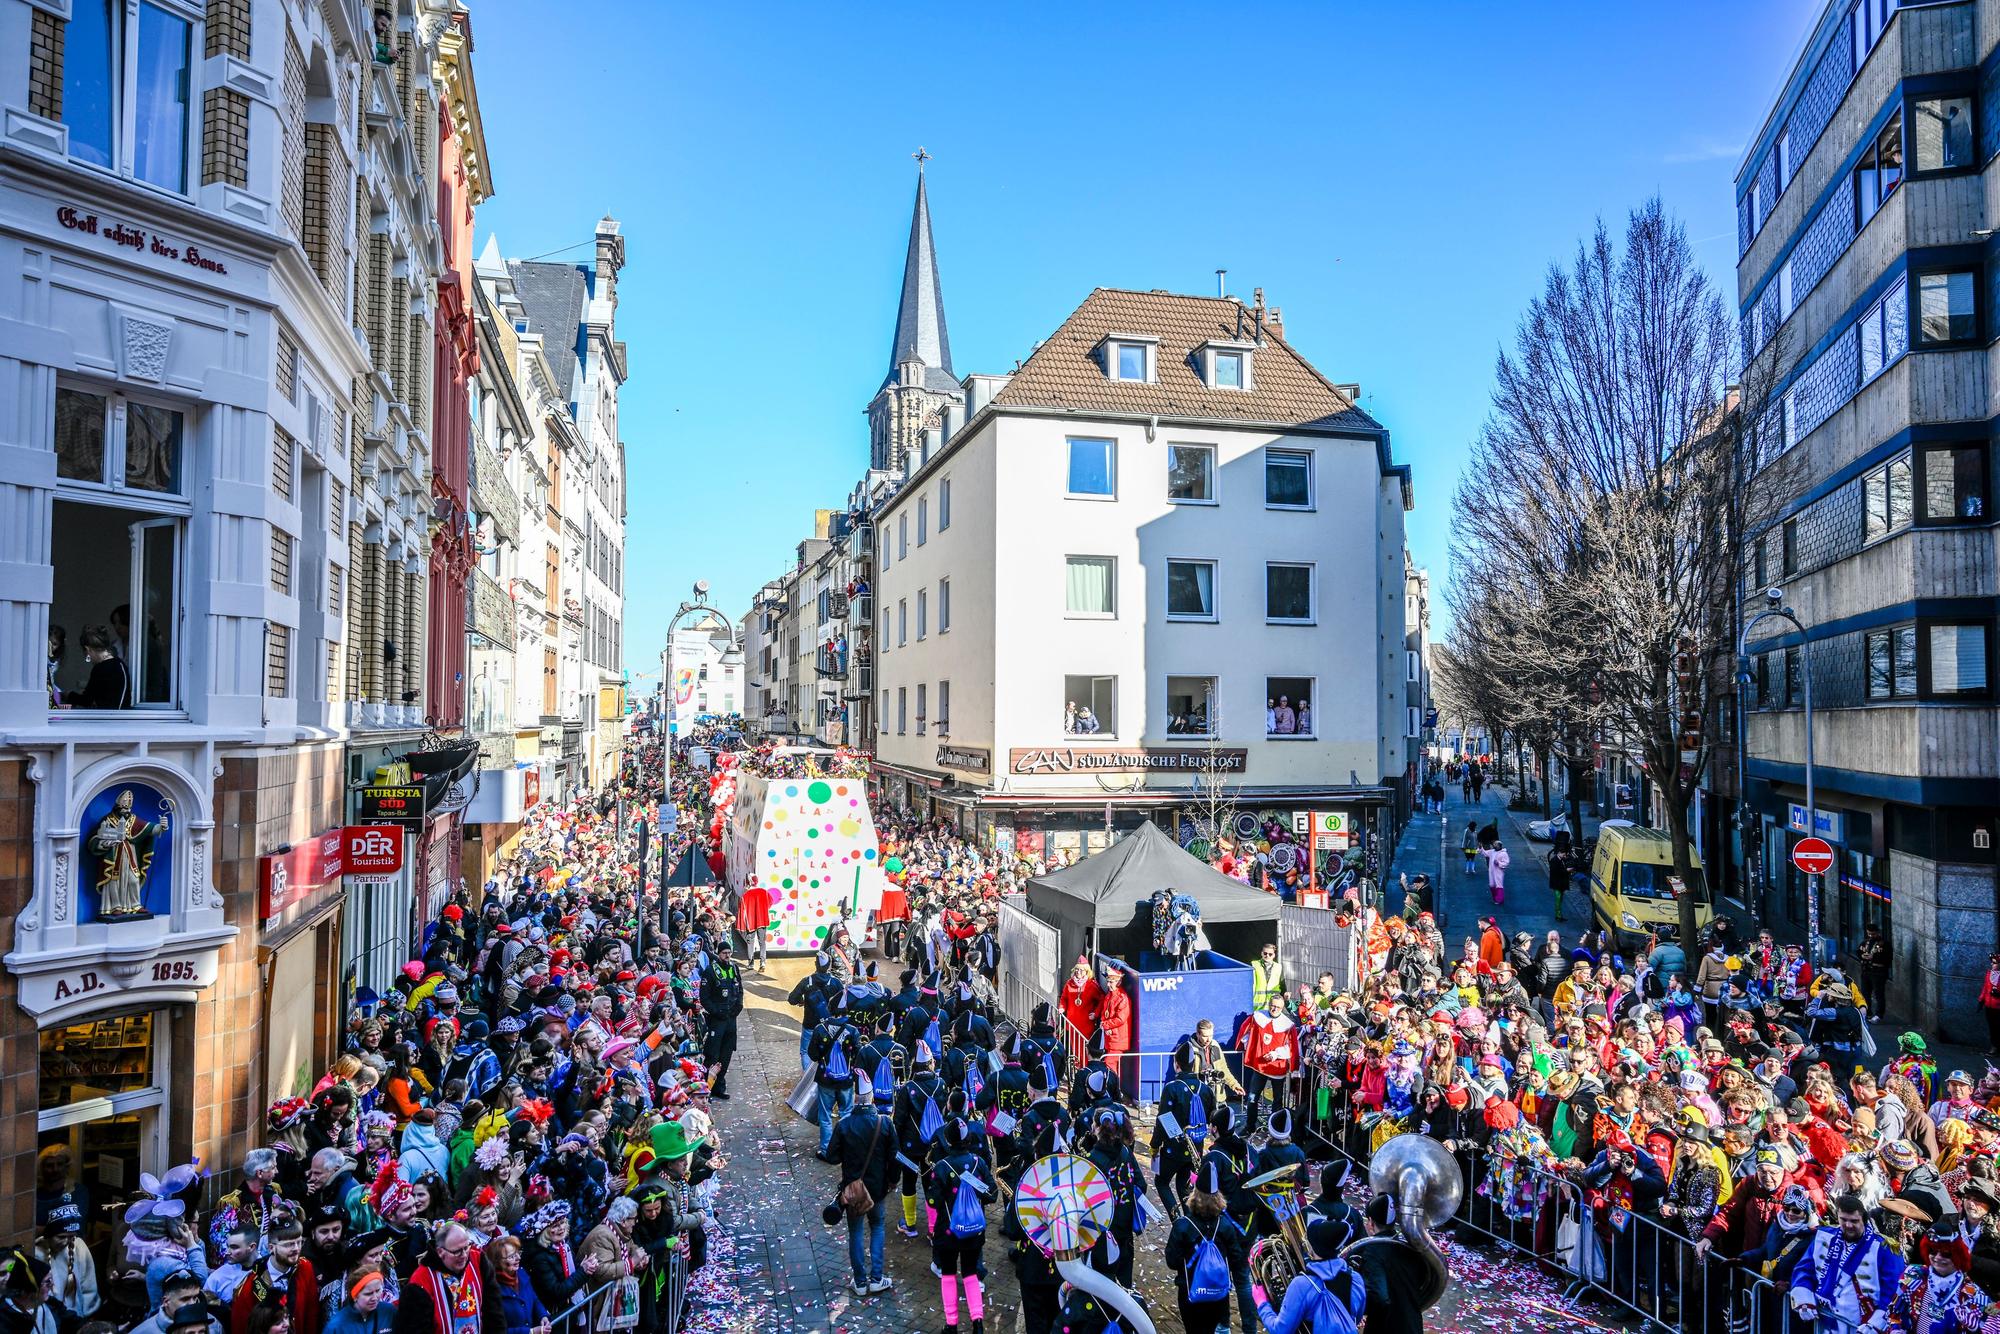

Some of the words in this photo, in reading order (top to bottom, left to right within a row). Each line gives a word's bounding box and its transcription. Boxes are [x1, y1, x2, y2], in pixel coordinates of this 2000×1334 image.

[57, 206, 98, 235] Gott
[151, 235, 179, 259] dies
[1015, 748, 1074, 774] CAN
[365, 789, 421, 798] TURISTA
[379, 798, 406, 809] SÜD
[352, 838, 394, 856] DER
[352, 858, 394, 866] Touristik
[353, 875, 390, 883] Partner
[55, 972, 105, 1000] A.D.
[152, 961, 199, 981] 1895.
[1143, 978, 1178, 992] WDR
